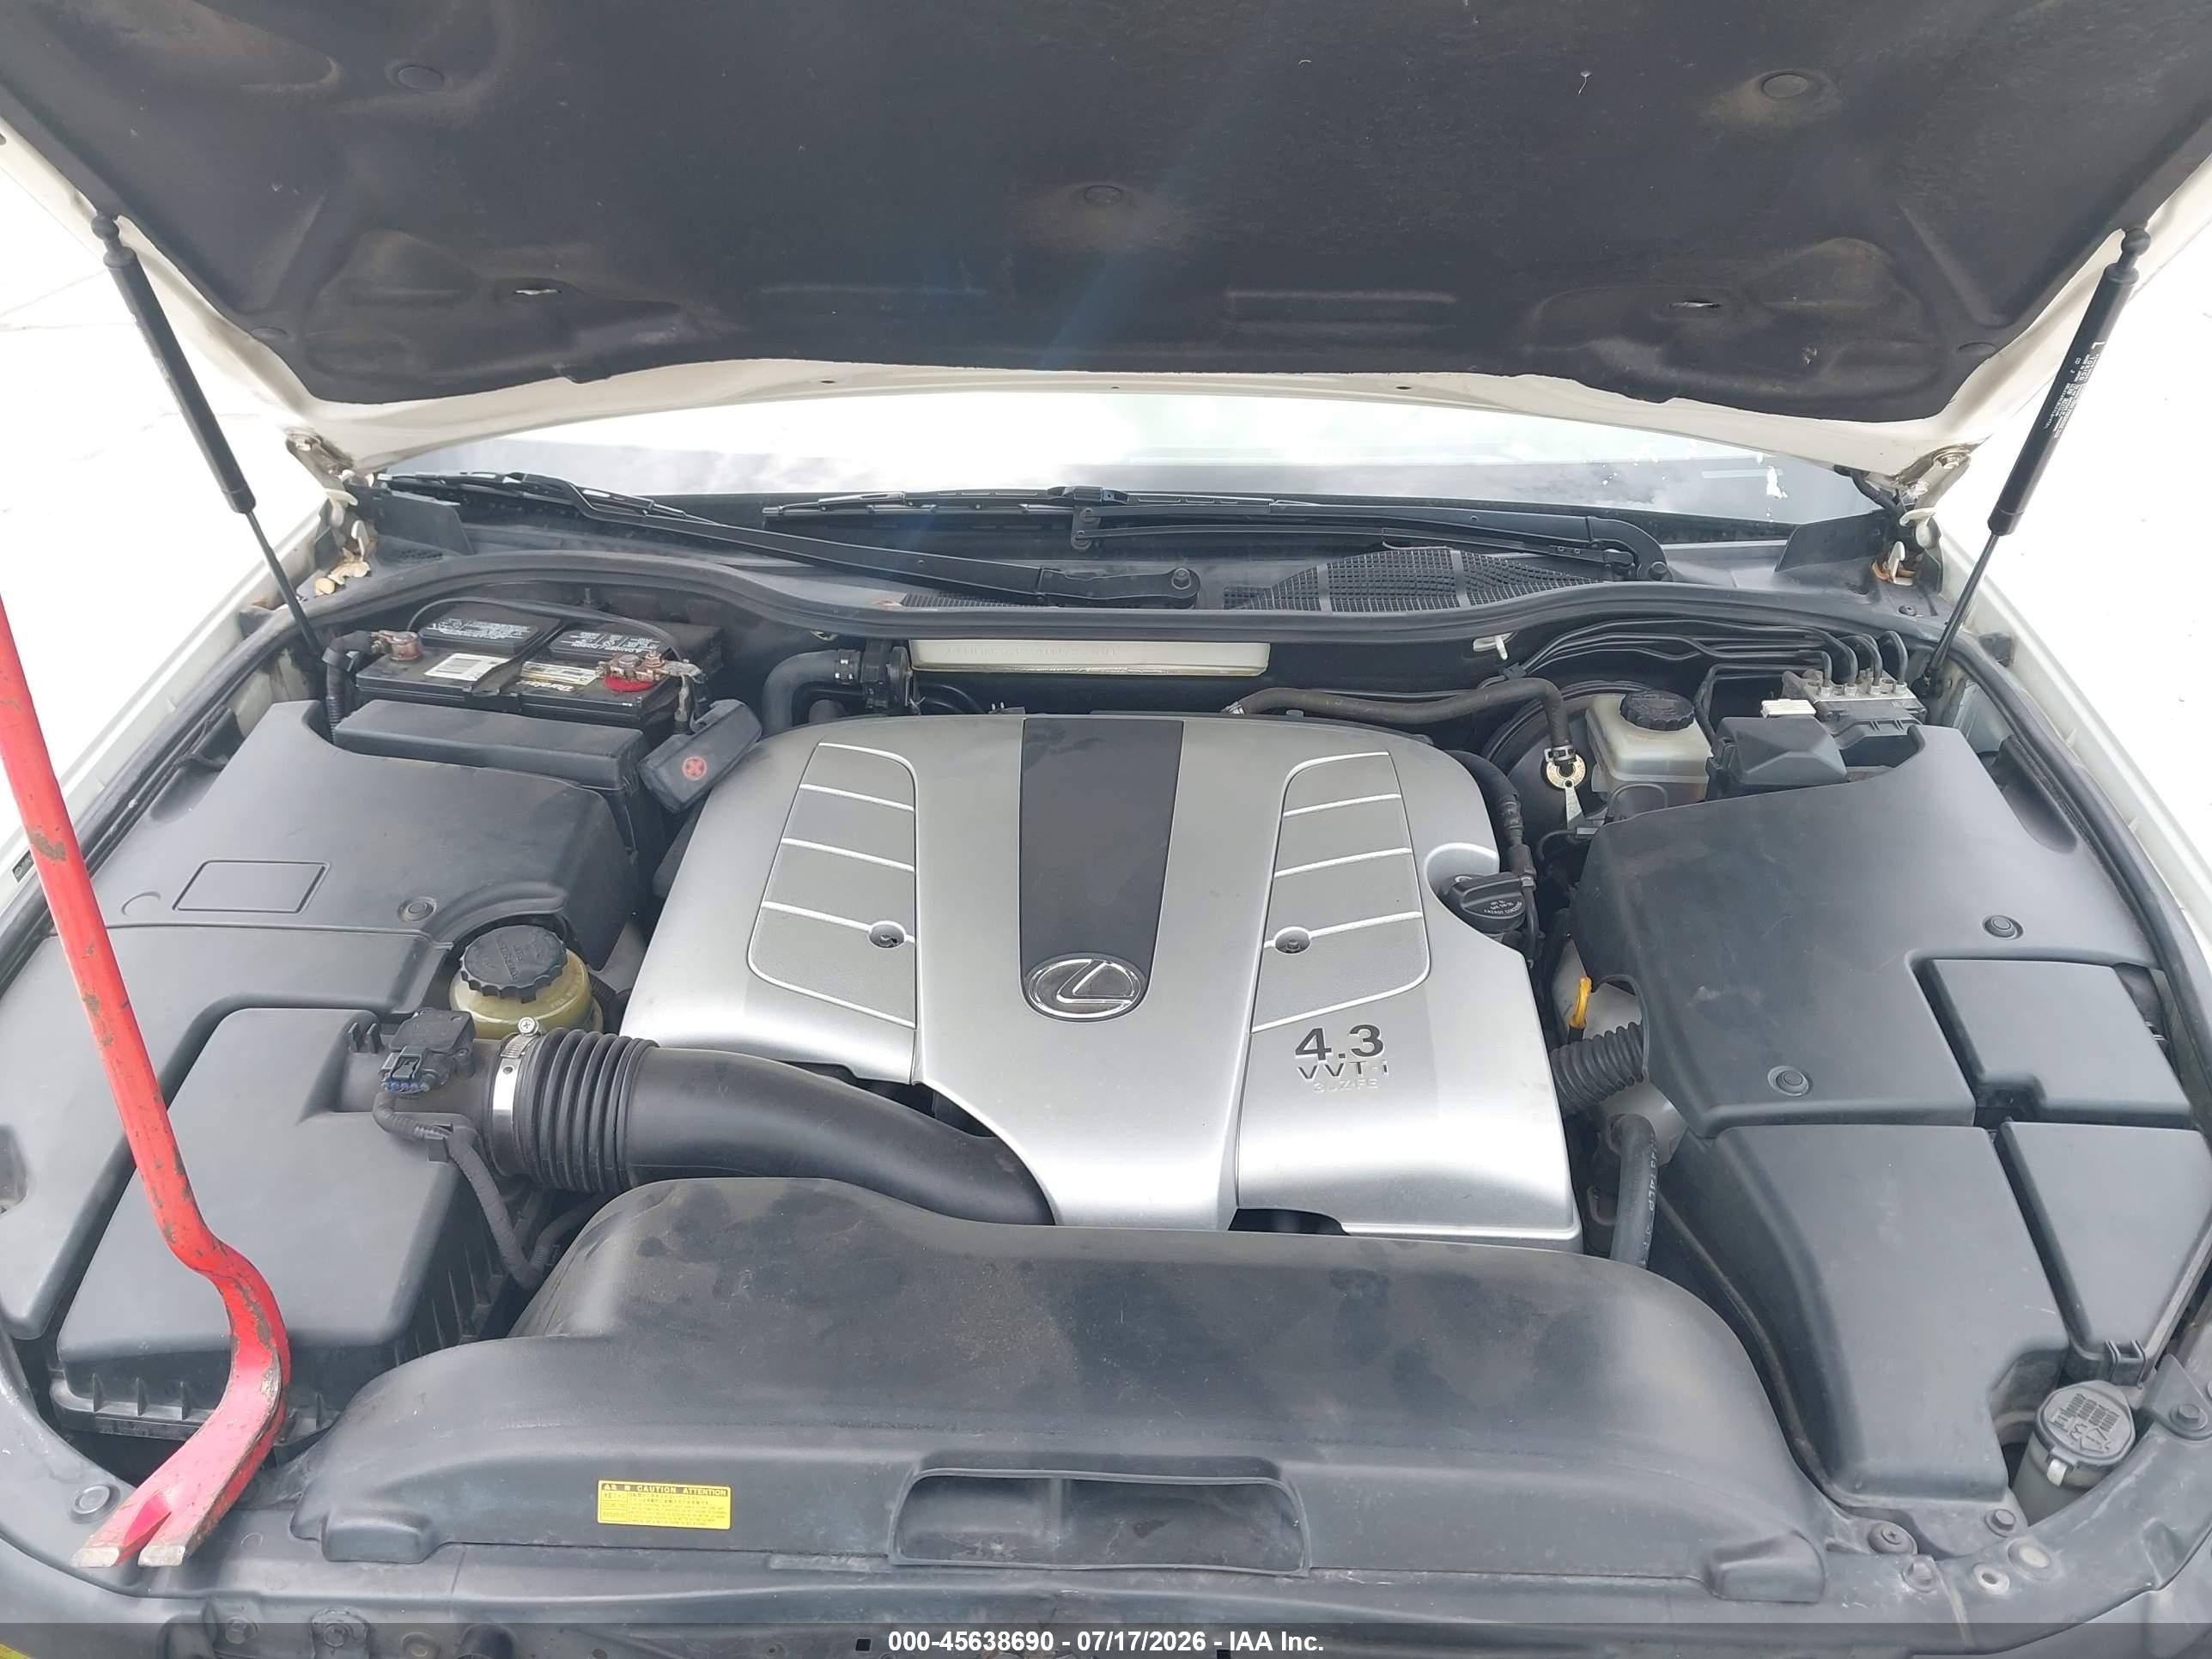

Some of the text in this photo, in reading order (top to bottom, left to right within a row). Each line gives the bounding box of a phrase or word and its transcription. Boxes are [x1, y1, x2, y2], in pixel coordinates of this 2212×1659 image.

[1295, 1024, 1384, 1060] 4.3
[637, 1486, 677, 1494] CAUTION
[683, 1487, 727, 1496] ATTENTION
